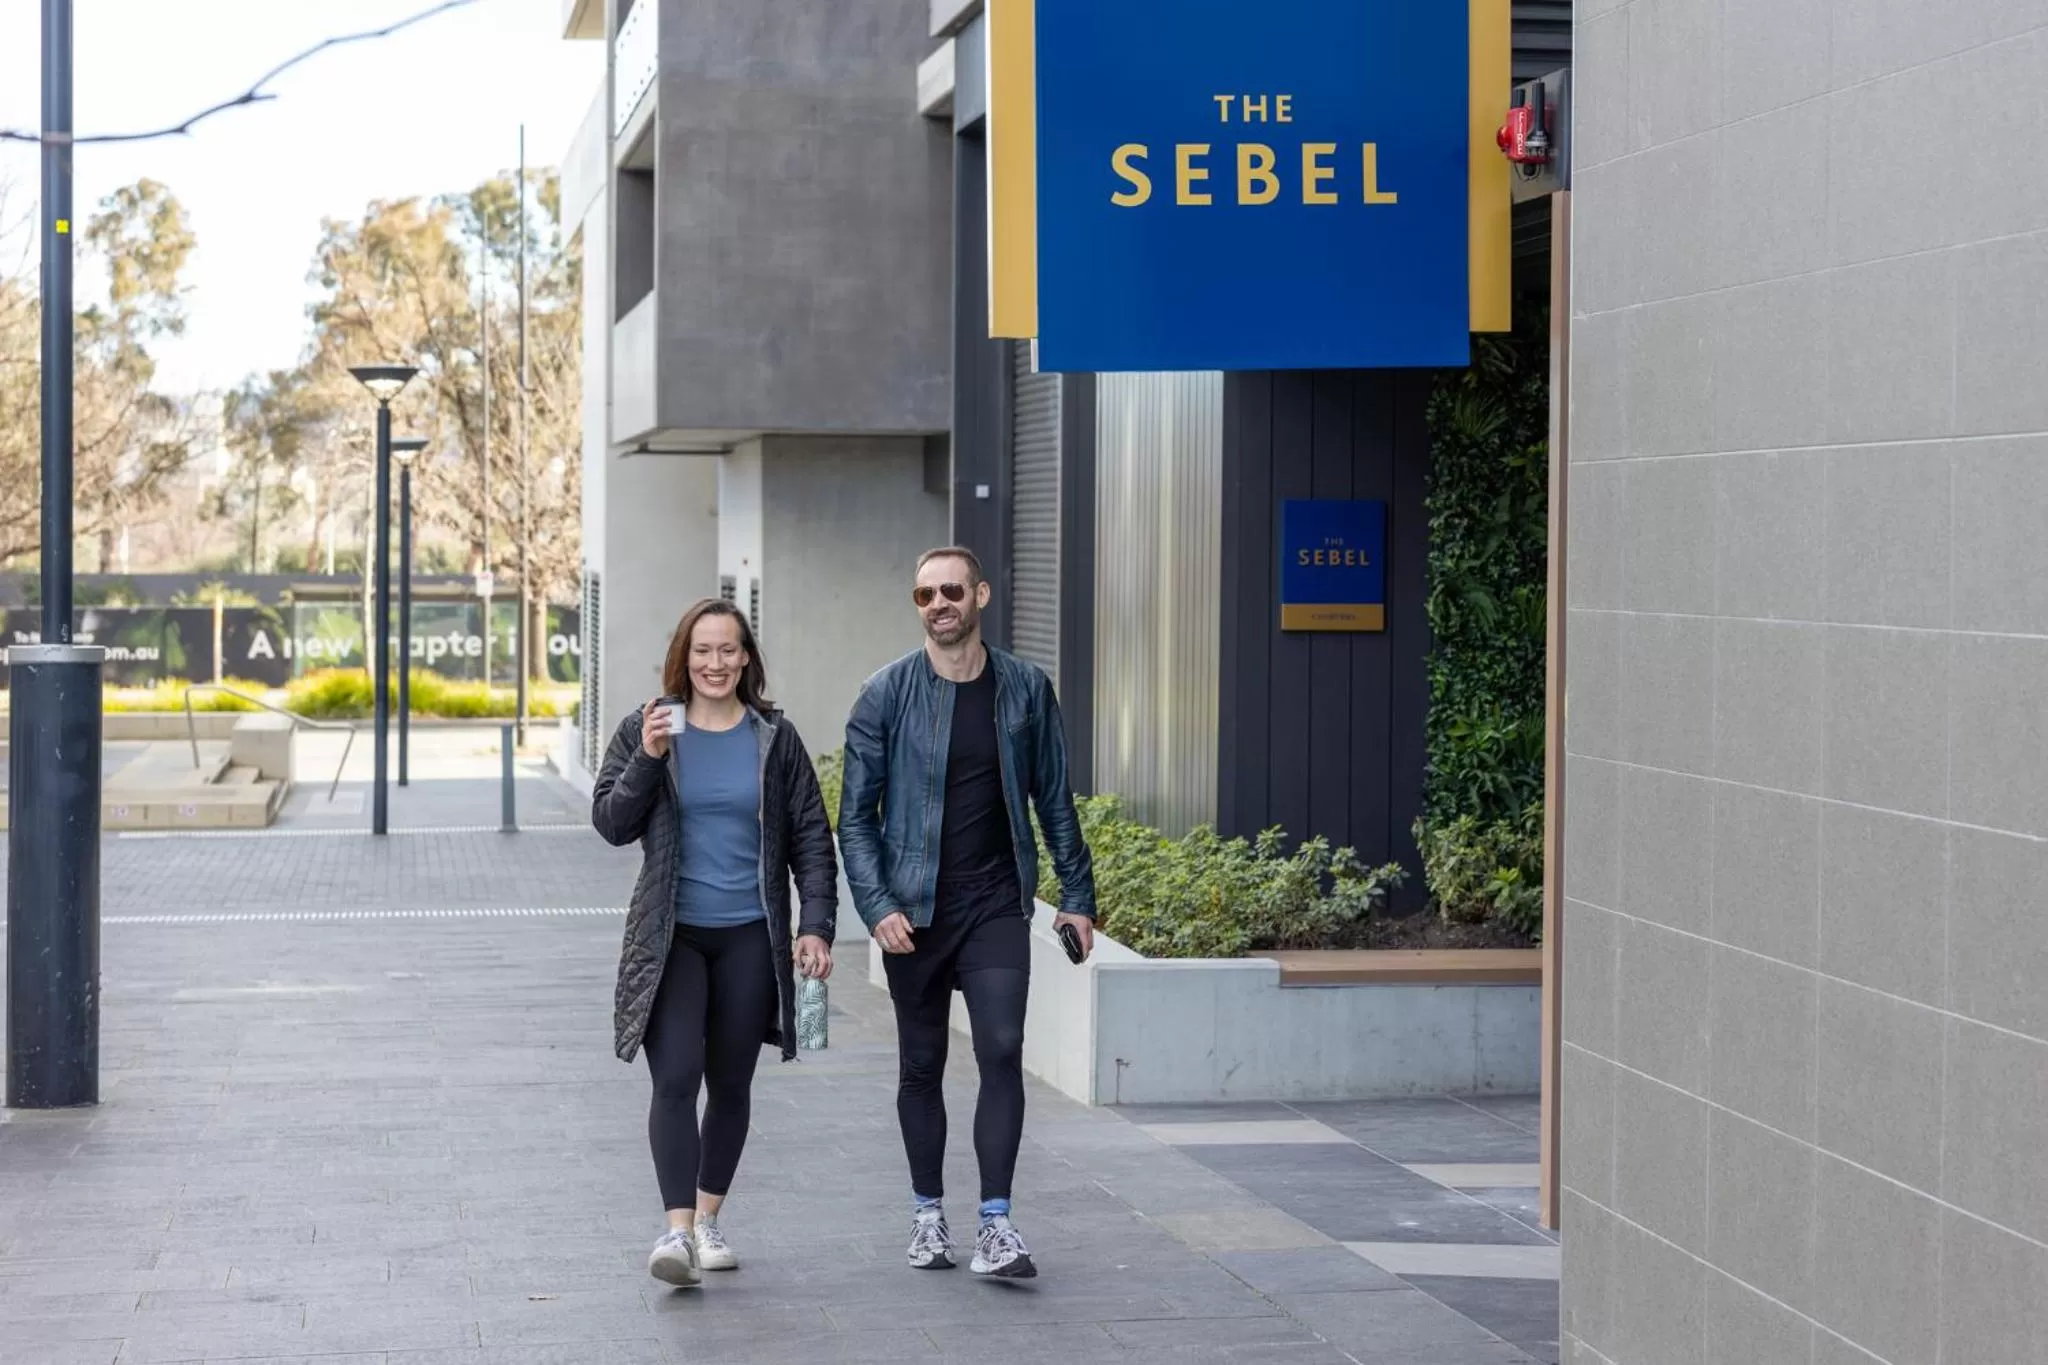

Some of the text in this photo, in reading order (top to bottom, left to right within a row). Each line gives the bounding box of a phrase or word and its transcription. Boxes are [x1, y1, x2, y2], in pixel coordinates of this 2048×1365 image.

[1214, 94, 1293, 122] THE
[1516, 111, 1525, 155] FIRE
[1110, 142, 1398, 207] SEBEL
[1298, 548, 1370, 566] SEBEL
[1324, 536, 1344, 546] THE
[247, 629, 275, 659] A
[283, 636, 354, 660] new
[387, 629, 497, 666] apter
[547, 634, 582, 656] ou
